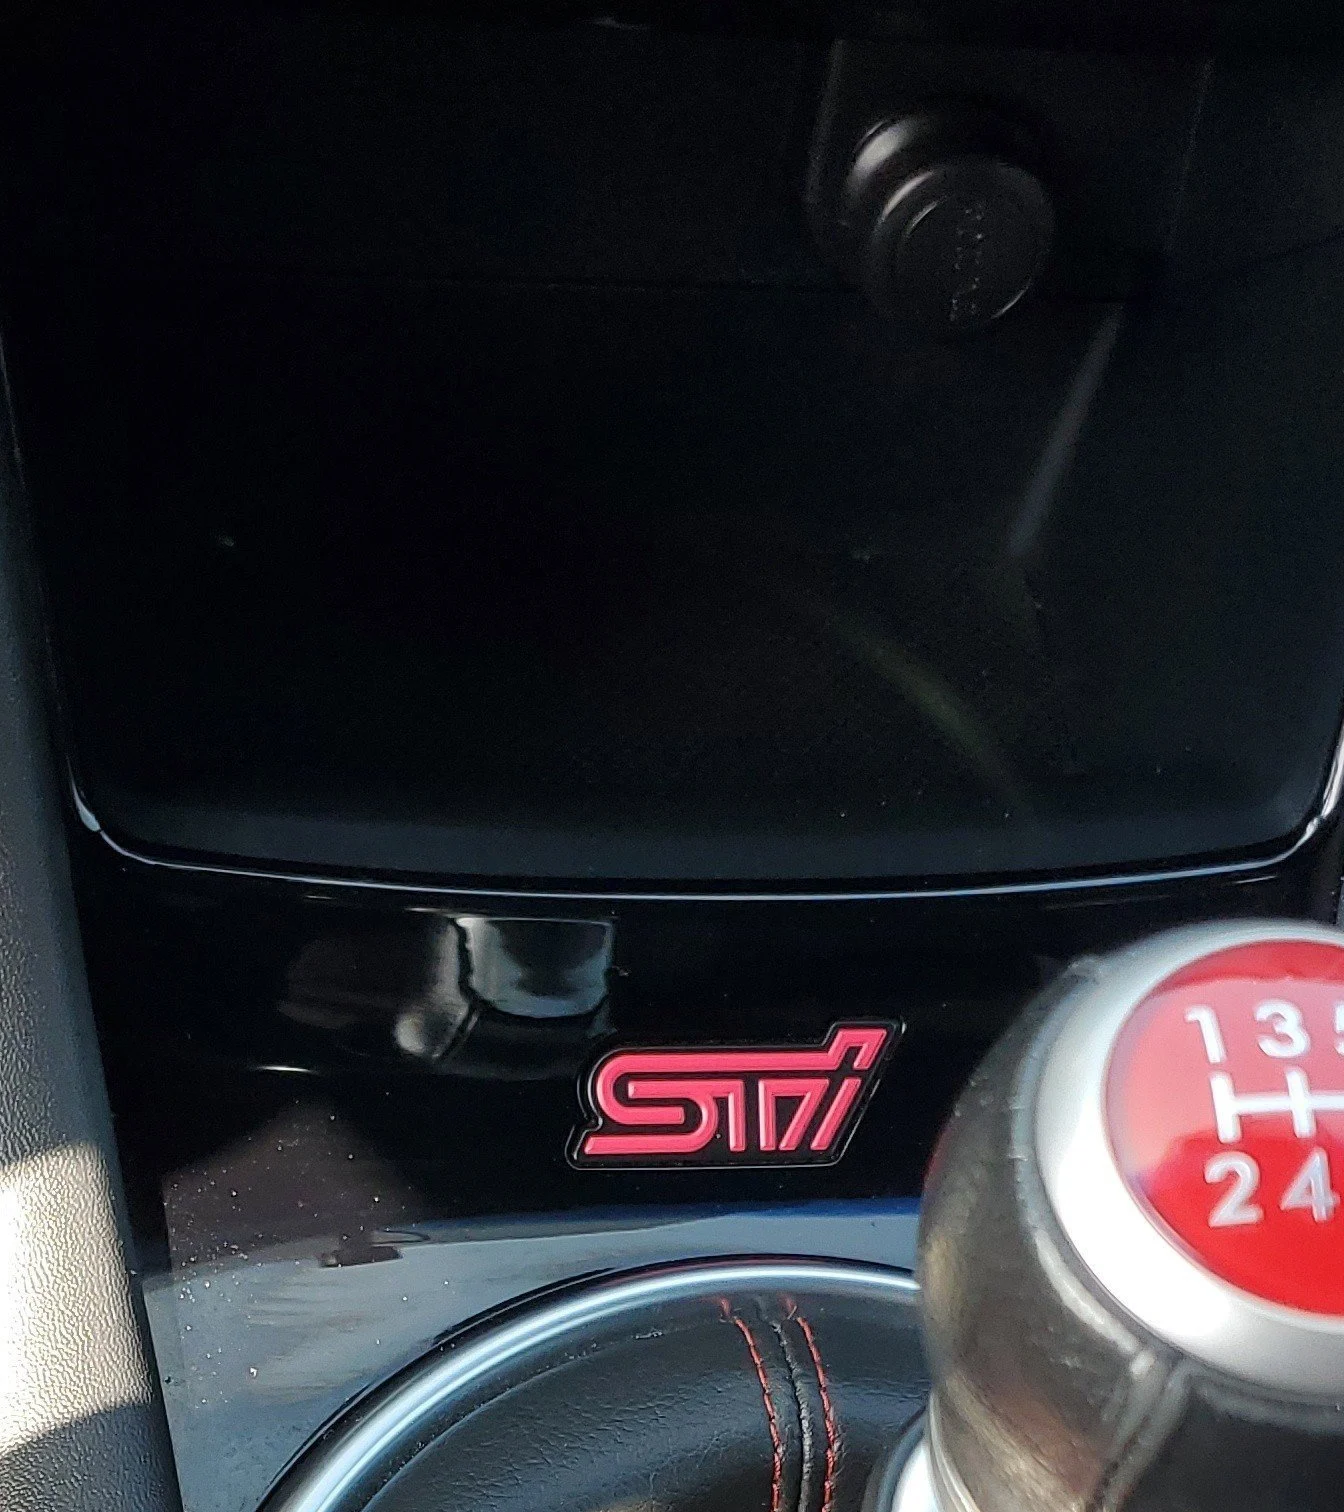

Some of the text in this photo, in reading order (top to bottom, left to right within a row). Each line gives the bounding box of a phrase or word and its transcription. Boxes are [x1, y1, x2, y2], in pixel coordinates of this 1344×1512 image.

[1185, 1004, 1227, 1063] 1
[1255, 1000, 1308, 1058] 3
[1205, 1151, 1264, 1228] 2
[1279, 1147, 1340, 1222] 4
